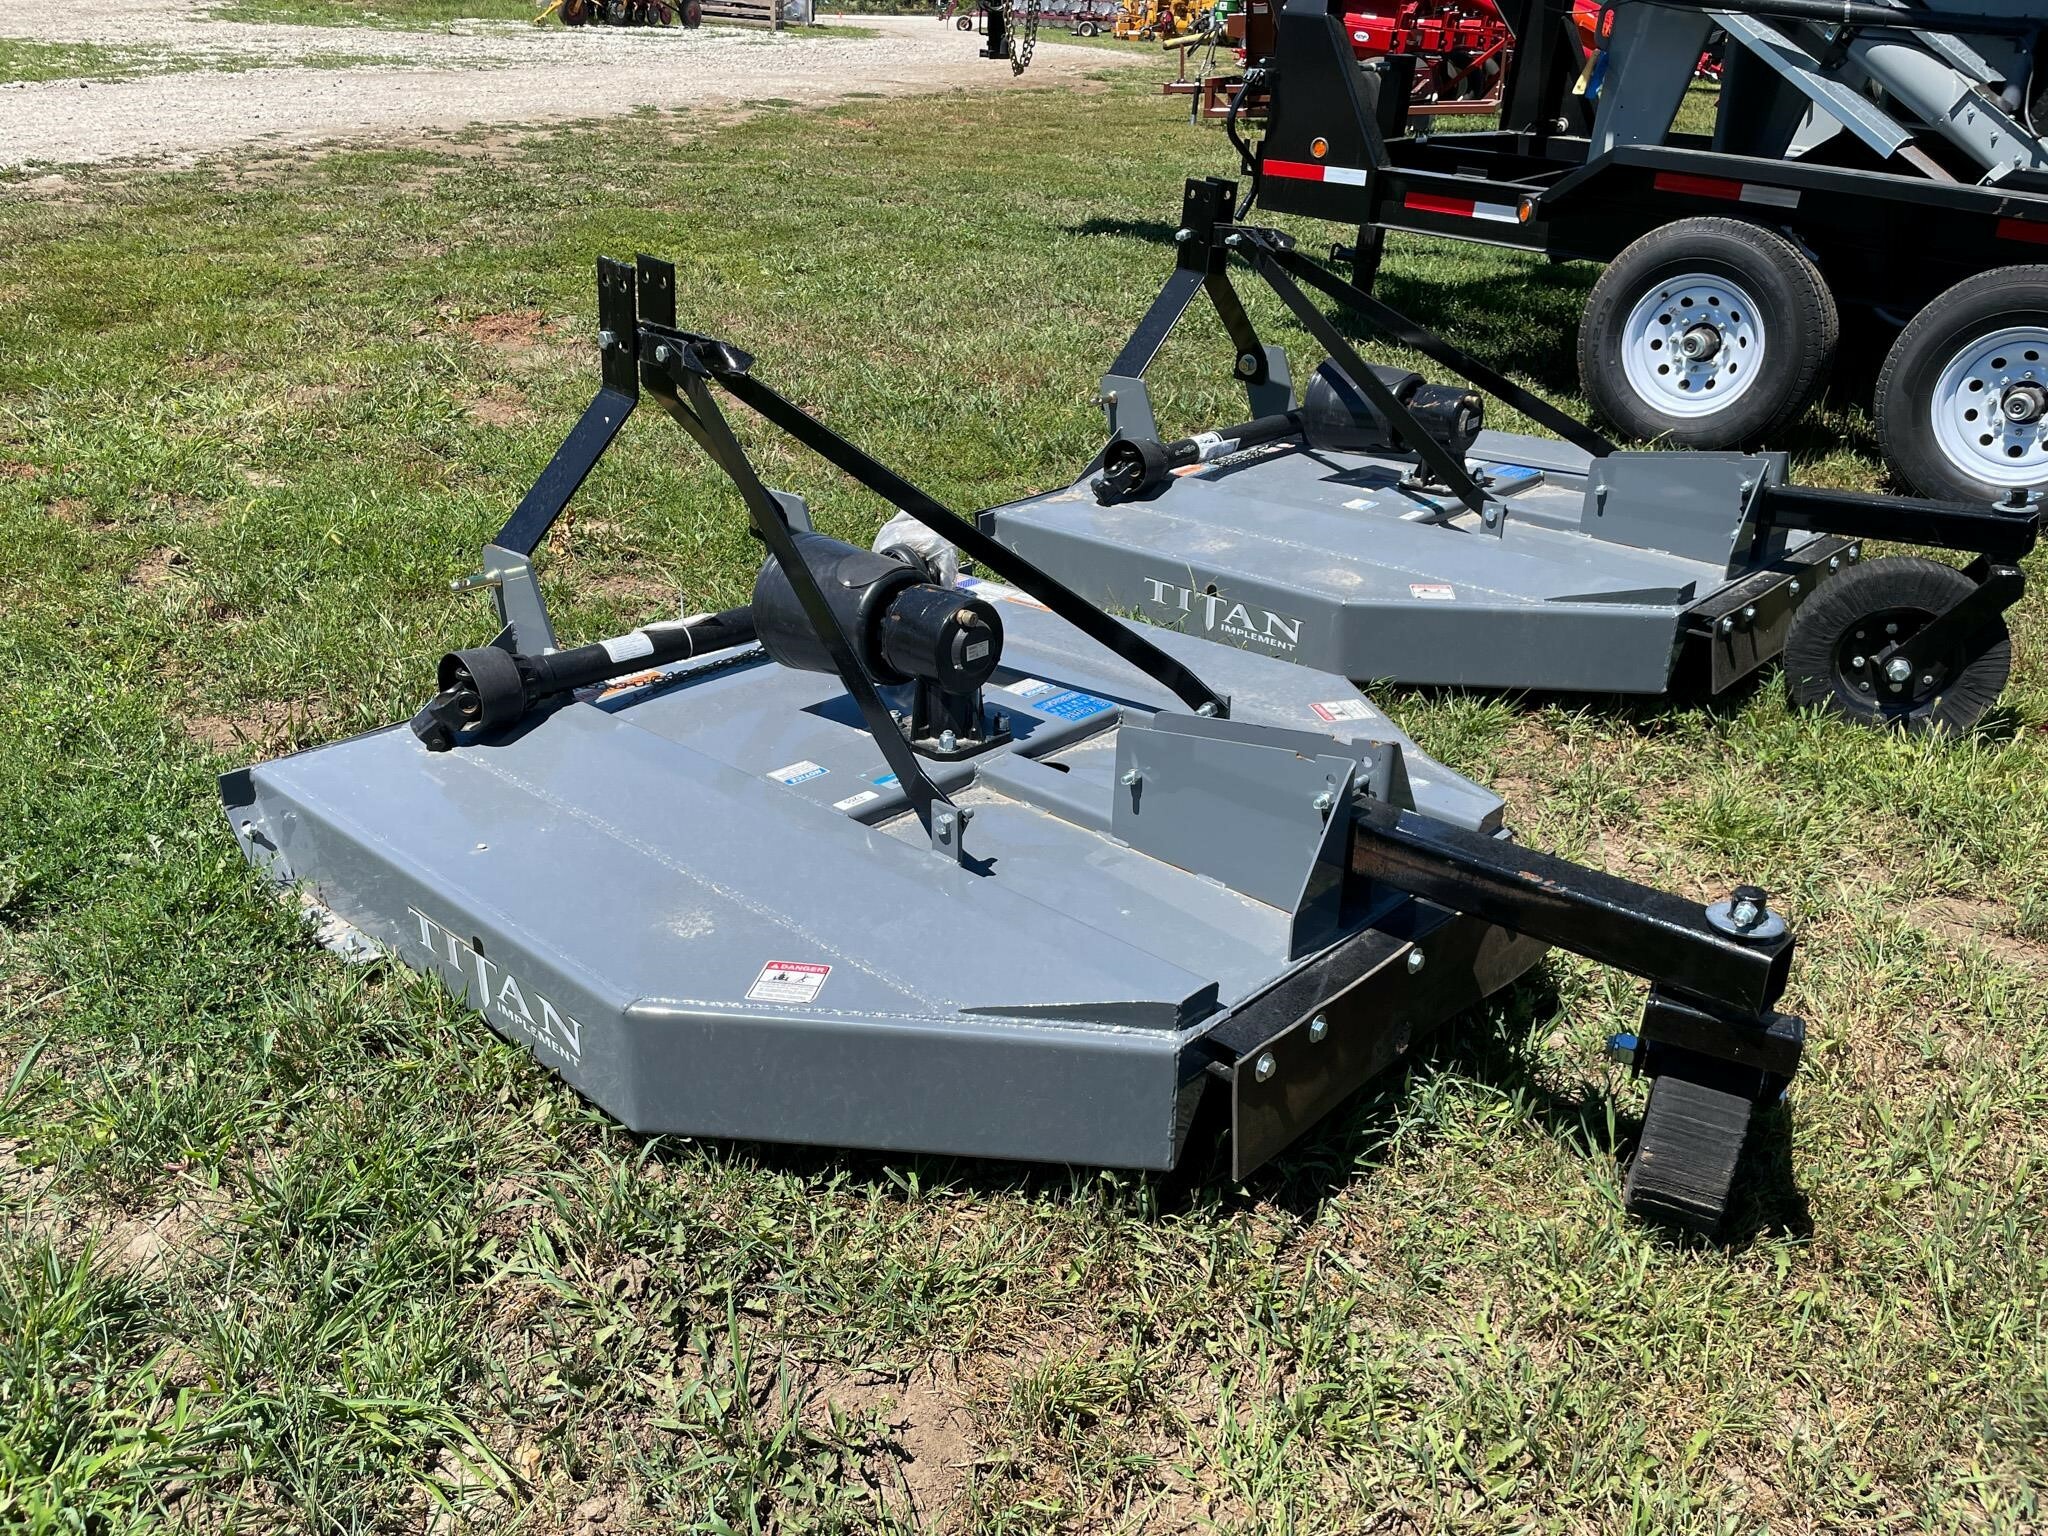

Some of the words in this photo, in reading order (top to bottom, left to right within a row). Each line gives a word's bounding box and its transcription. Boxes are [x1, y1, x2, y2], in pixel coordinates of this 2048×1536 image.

[1144, 577, 1304, 645] TITAN
[1220, 623, 1296, 652] IMPLEMENT
[408, 904, 584, 1058] TITAN
[780, 963, 826, 974] DANGER
[496, 1003, 580, 1068] IMPLEMENT
